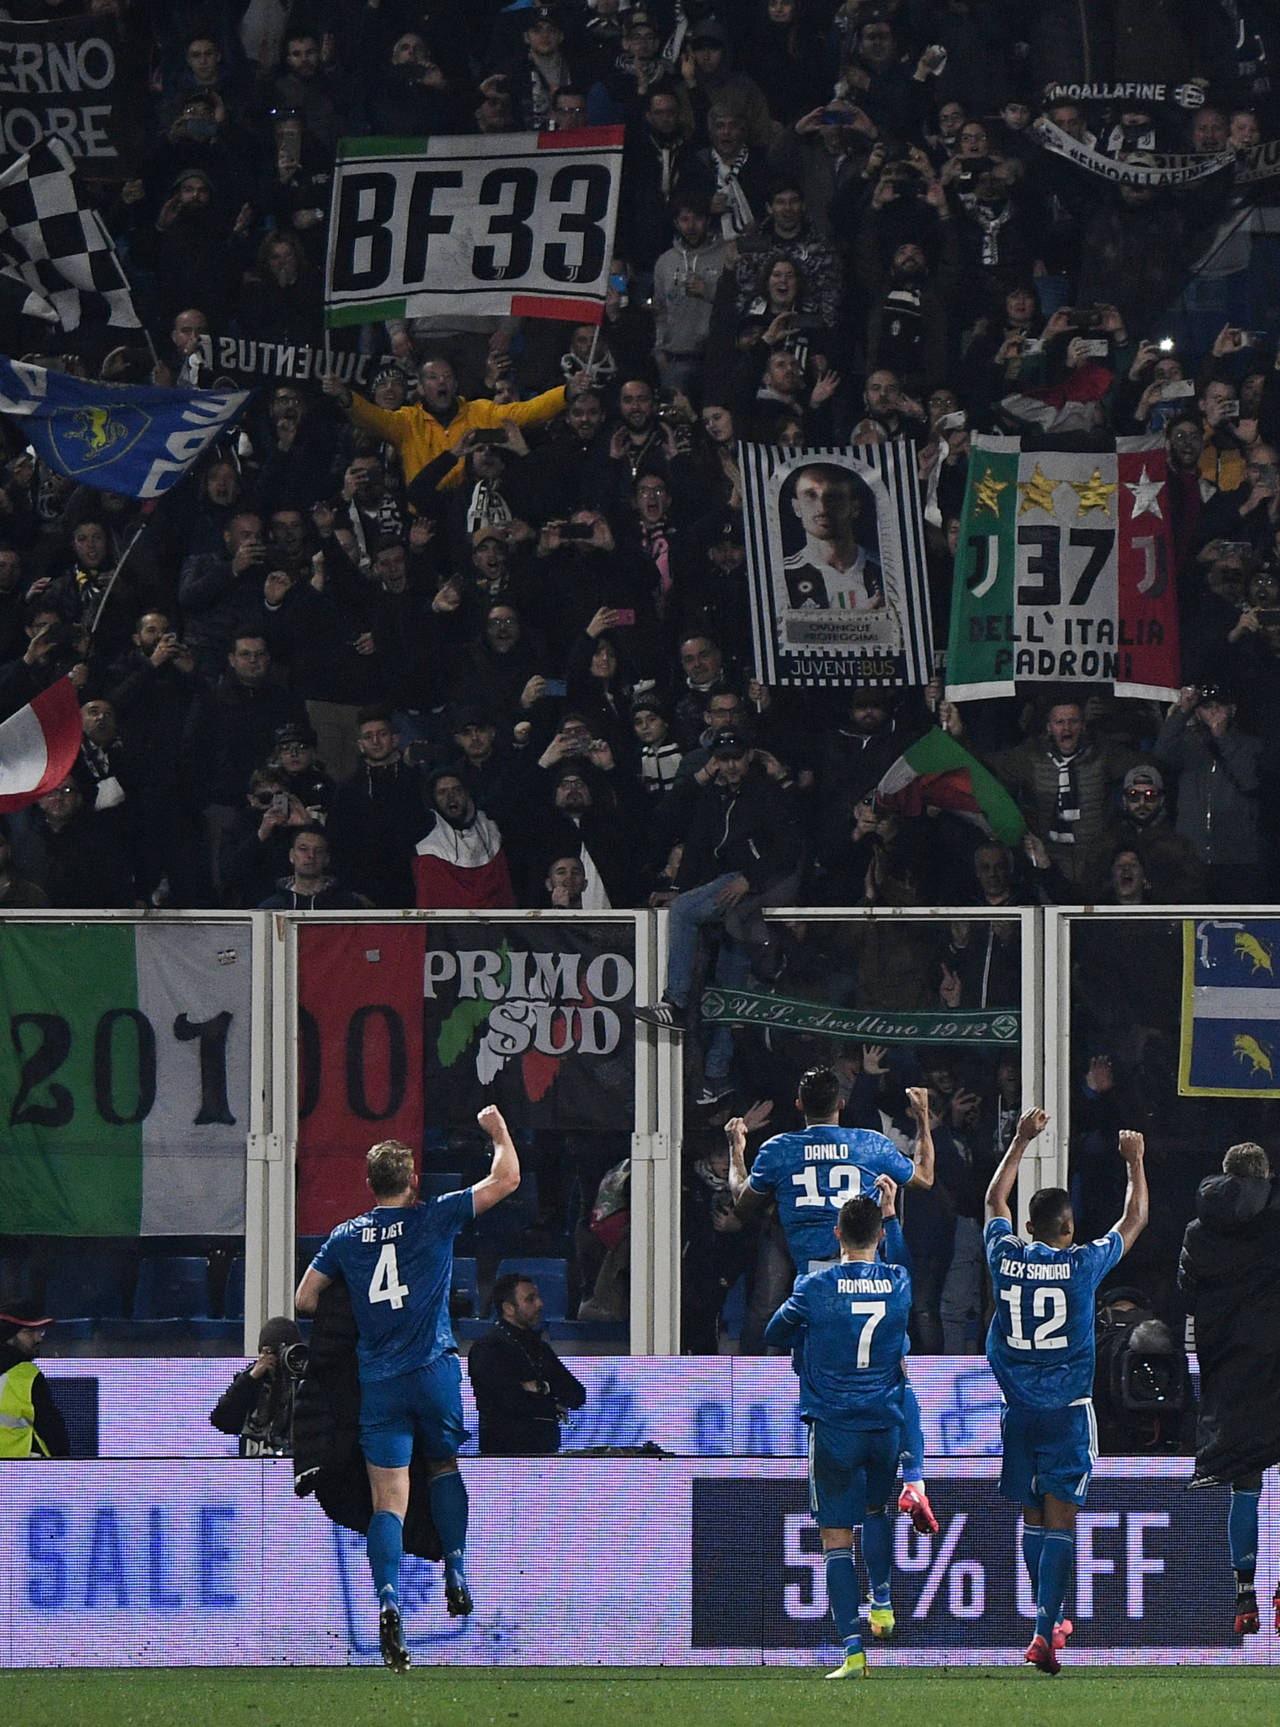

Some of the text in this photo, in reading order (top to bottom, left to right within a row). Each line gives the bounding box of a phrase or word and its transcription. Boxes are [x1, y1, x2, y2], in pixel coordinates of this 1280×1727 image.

[0, 104, 119, 157] ORE
[331, 163, 612, 292] BF33
[1017, 525, 1116, 606] 37
[994, 649, 1133, 679] PADRONI
[424, 950, 635, 1001] PRIMO
[487, 1000, 622, 1056] SUD
[798, 1011, 920, 1036] Avellino
[928, 1022, 988, 1037] 1912
[804, 1143, 849, 1161] DANILO
[791, 1165, 862, 1209] 13
[361, 1227, 378, 1243] DE
[368, 1243, 410, 1310] 4
[837, 1278, 893, 1294] RONALDO
[1000, 1258, 1071, 1280] ALEX SANDRO
[851, 1301, 887, 1369] 7
[1000, 1284, 1068, 1350] 12
[25, 1504, 238, 1611] SALE
[783, 1512, 985, 1618] 5%
